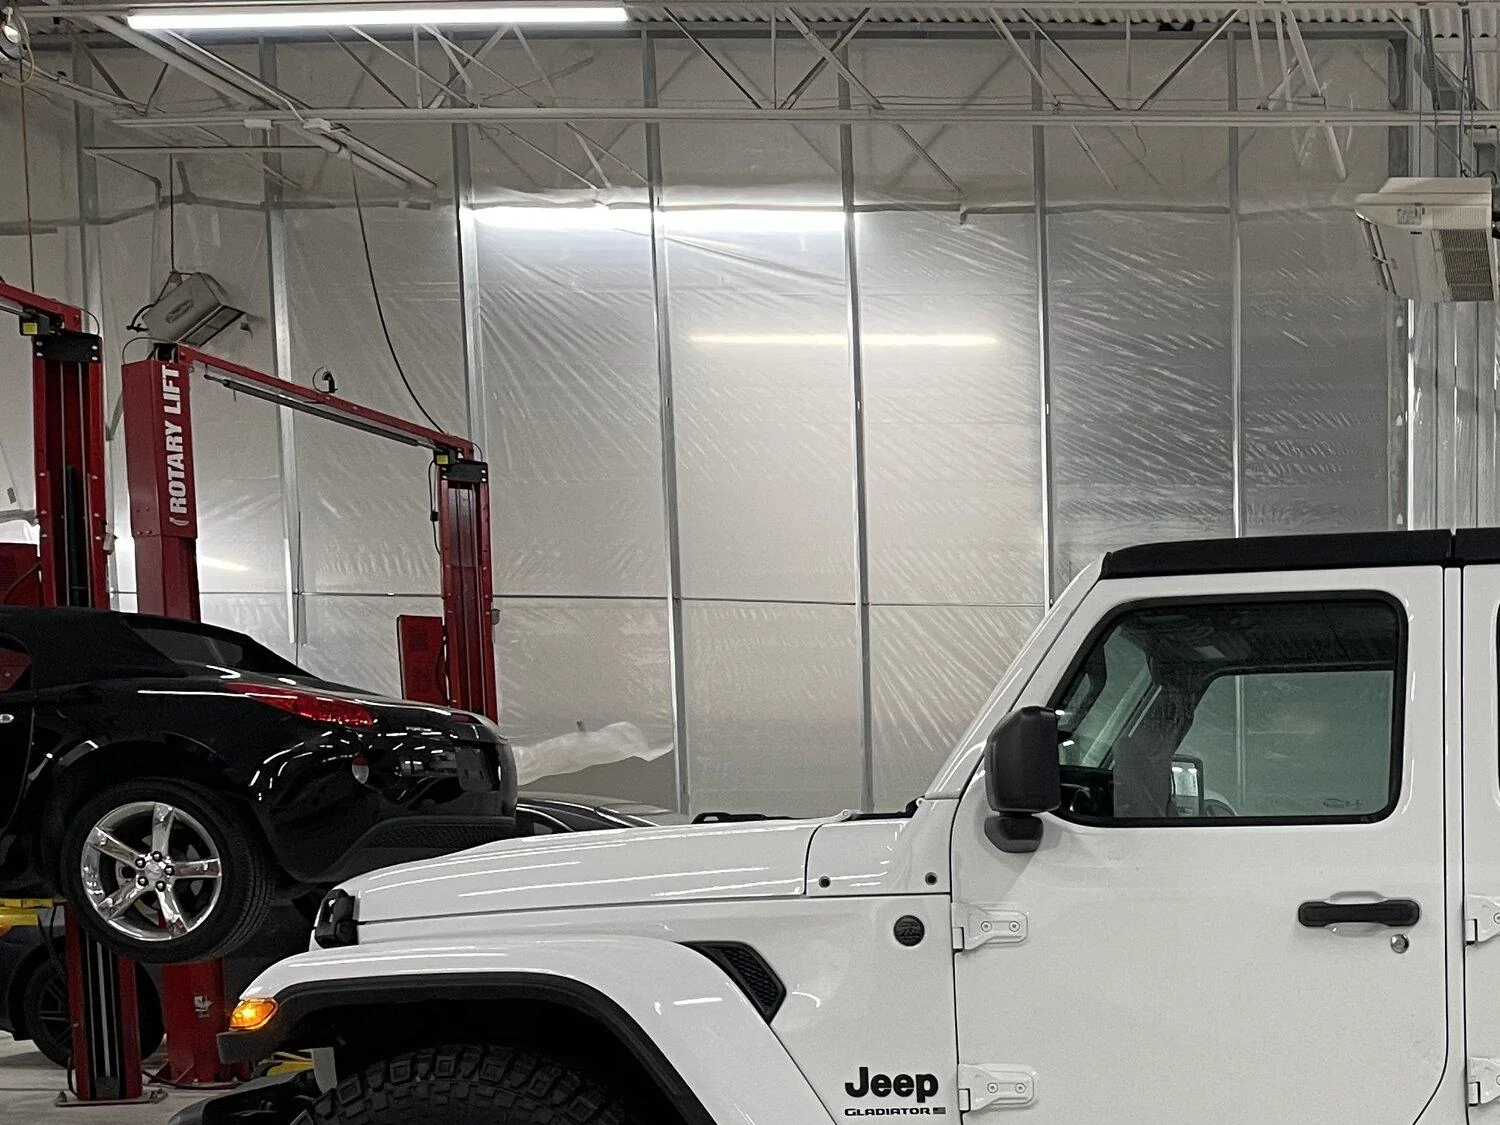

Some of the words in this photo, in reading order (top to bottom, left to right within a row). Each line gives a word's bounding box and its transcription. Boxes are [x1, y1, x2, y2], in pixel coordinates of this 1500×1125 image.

[161, 364, 182, 415] LIFT
[164, 420, 188, 514] ROTARY
[845, 1066, 939, 1103] Jeep
[844, 1107, 931, 1116] GLADIATOR
